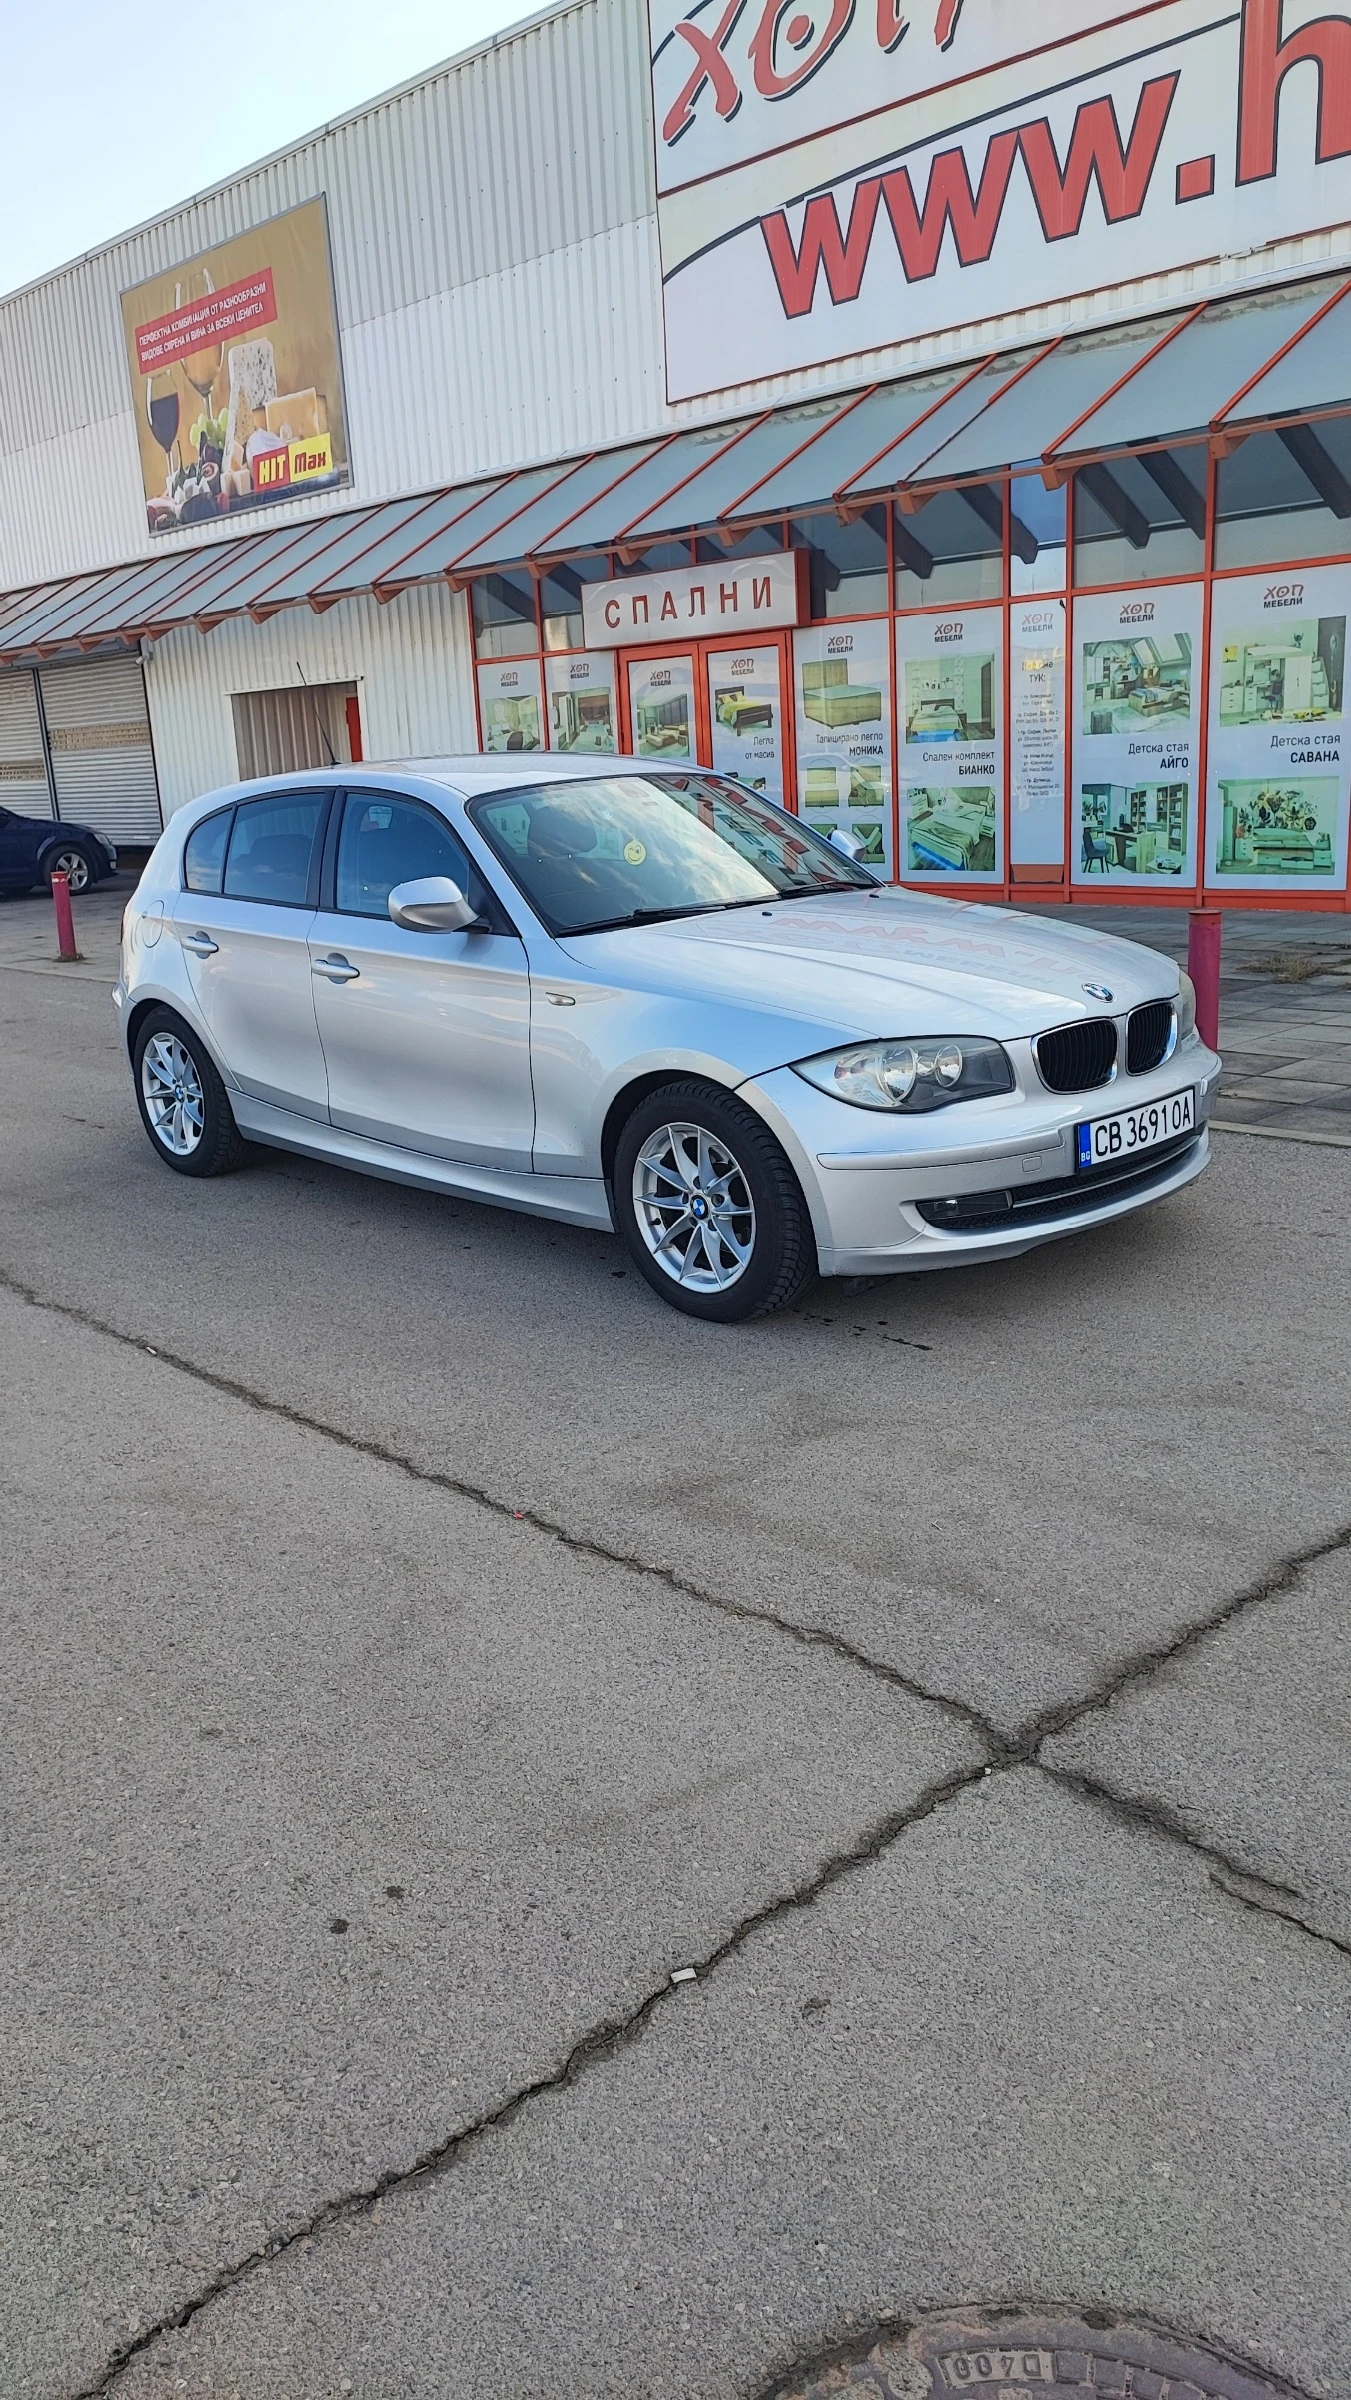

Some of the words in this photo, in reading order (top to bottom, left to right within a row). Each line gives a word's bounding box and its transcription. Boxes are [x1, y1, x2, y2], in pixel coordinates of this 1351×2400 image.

[139, 327, 172, 347] ПЕРФЕКТНА
[171, 306, 211, 332] КОМБИНАЦИЯ
[210, 302, 219, 317] ОТ
[219, 282, 267, 313] РАЗНООБРАЗНИ
[141, 343, 164, 362] ВИДОВЕ
[163, 334, 186, 352] СИРЕНА
[191, 327, 207, 341] ВИНА
[206, 322, 216, 335] ЗА
[216, 315, 236, 331] ВСЕКИ
[235, 301, 264, 323] ЦЕНИТЕЛ
[258, 454, 286, 485] HIT
[1263, 584, 1304, 600] ХОП
[604, 576, 772, 629] СПАЛНИ
[1263, 597, 1303, 608] МЕБЕЛИ
[1119, 602, 1155, 616] ХОП
[1022, 612, 1054, 625] ХОП
[1119, 614, 1154, 624] МЕБЕЛИ
[934, 623, 964, 635] ХОП
[1022, 624, 1053, 633] МЕБЕЛИ
[828, 635, 853, 647] ХОП
[934, 634, 963, 643] МЕБЕЛИ
[828, 646, 853, 654] МЕБЕЛИ
[570, 663, 590, 673] ХОП
[731, 658, 754, 670] ХОП
[500, 672, 519, 682] ХОП
[650, 670, 671, 681] ХОП
[731, 668, 754, 676] МЕБЕЛИ
[1029, 673, 1046, 683] ТУК:
[753, 736, 774, 746] Легла
[815, 733, 859, 746] Тапицирано
[860, 732, 884, 742] легло
[1270, 735, 1311, 748] Детска
[1314, 735, 1341, 746] стая
[849, 744, 884, 756] МОНИКА
[1128, 743, 1163, 755] Детска
[1166, 742, 1189, 752] стая
[744, 752, 752, 760] от
[753, 750, 775, 760] масив
[922, 752, 953, 762] Спален
[955, 751, 995, 763] комплект
[1290, 751, 1340, 764] САВАНА
[1160, 756, 1189, 769] АЙГО
[958, 764, 995, 775] БИАНКО
[1095, 1121, 1122, 1157] CB
[1127, 1105, 1168, 1147] 3691
[1172, 1096, 1191, 1130] OA
[1081, 1150, 1091, 1162] BG
